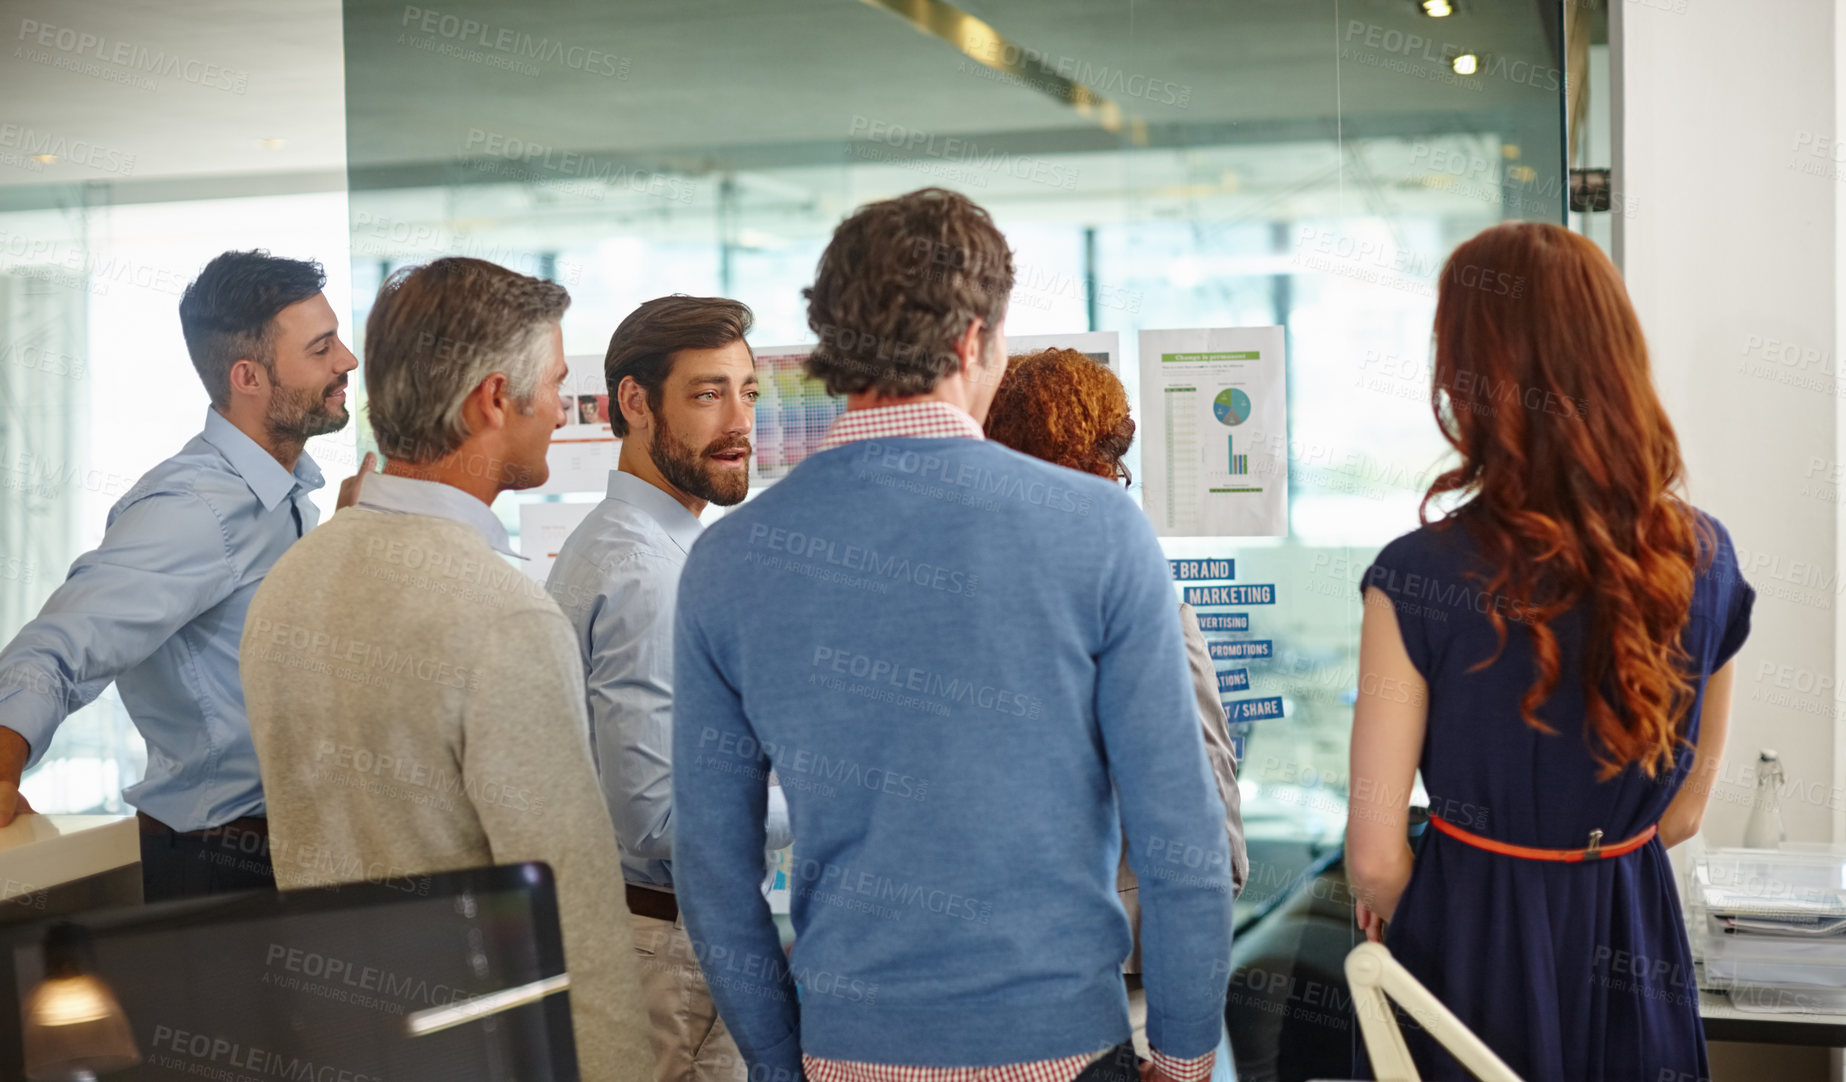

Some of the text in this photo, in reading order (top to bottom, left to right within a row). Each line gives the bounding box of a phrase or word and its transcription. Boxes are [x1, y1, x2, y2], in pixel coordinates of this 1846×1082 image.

[1180, 561, 1229, 579] BRAND
[1189, 586, 1271, 605] MARKETING
[1211, 643, 1268, 657] PROMOTIONS
[1242, 701, 1279, 717] SHARE
